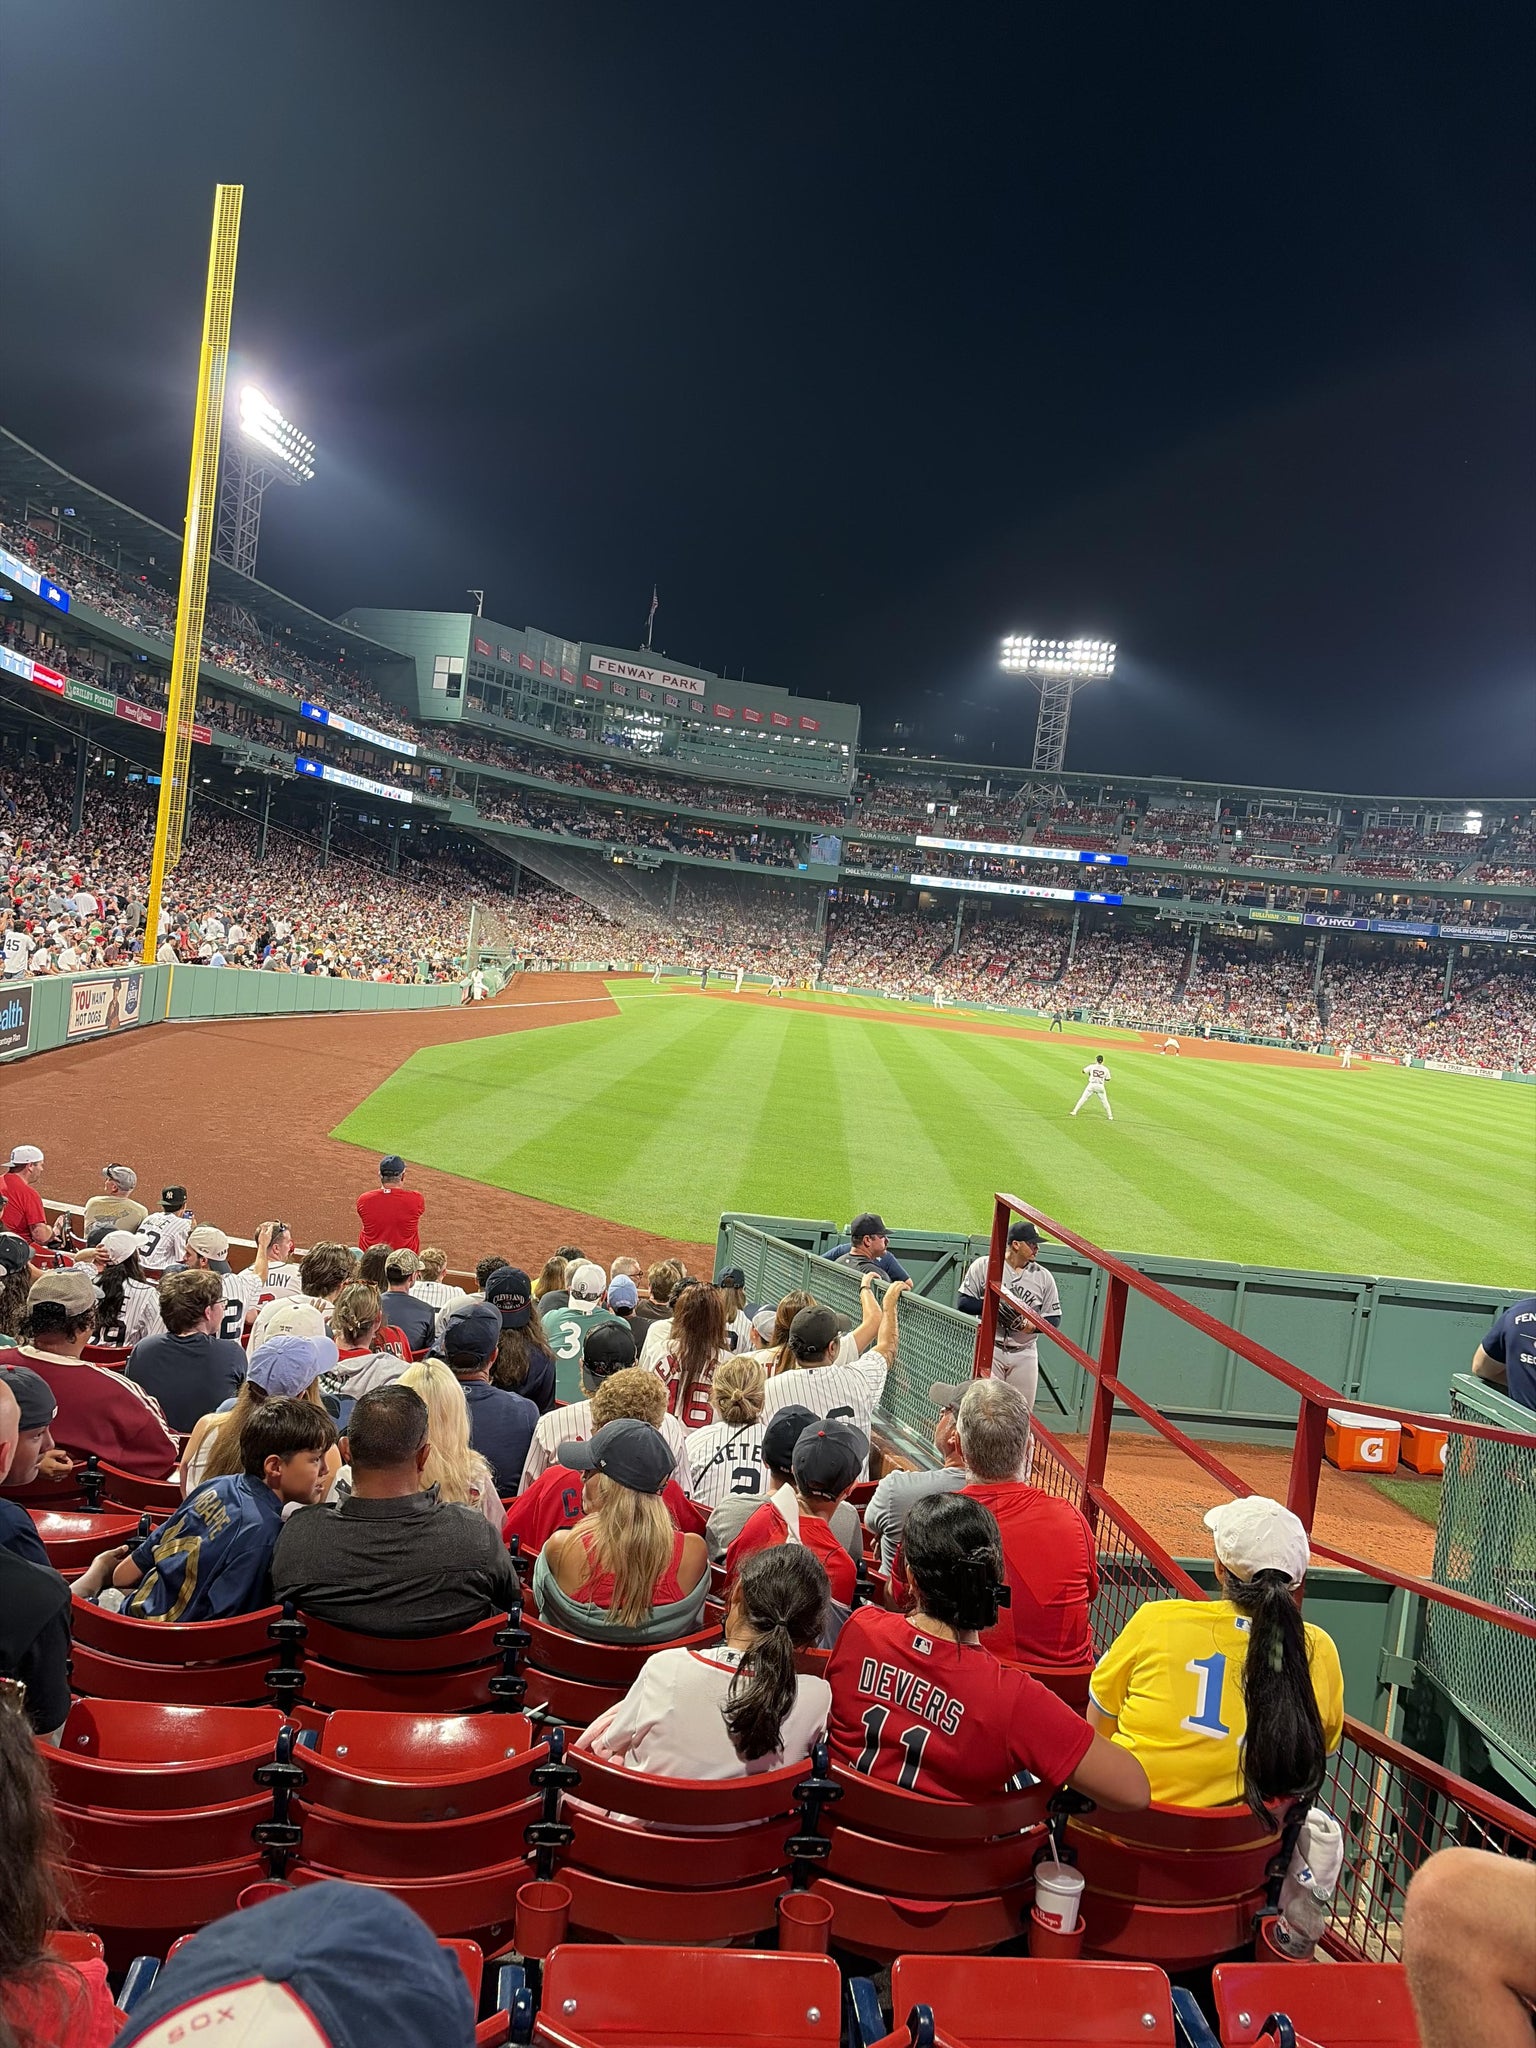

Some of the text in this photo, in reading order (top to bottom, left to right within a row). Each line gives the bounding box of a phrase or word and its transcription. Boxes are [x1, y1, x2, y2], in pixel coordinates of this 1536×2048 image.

[598, 660, 655, 681] FENWAY
[662, 674, 697, 691] PARK
[1329, 918, 1356, 928] HYCU
[5, 938, 20, 952] 45
[75, 990, 91, 1011] YOU
[75, 1011, 102, 1027] HOT DOGS
[493, 1293, 525, 1305] CLEVELAND
[220, 1299, 244, 1340] 2
[556, 1321, 582, 1360] 3
[667, 1378, 714, 1428] 16
[714, 1443, 763, 1465] JETE
[1360, 1437, 1384, 1463] G
[730, 1466, 761, 1495] 2
[858, 1656, 965, 1736] DEVERS
[1180, 1652, 1246, 1747] 1
[848, 1703, 931, 1789] 11
[167, 2004, 235, 2045] SOX
